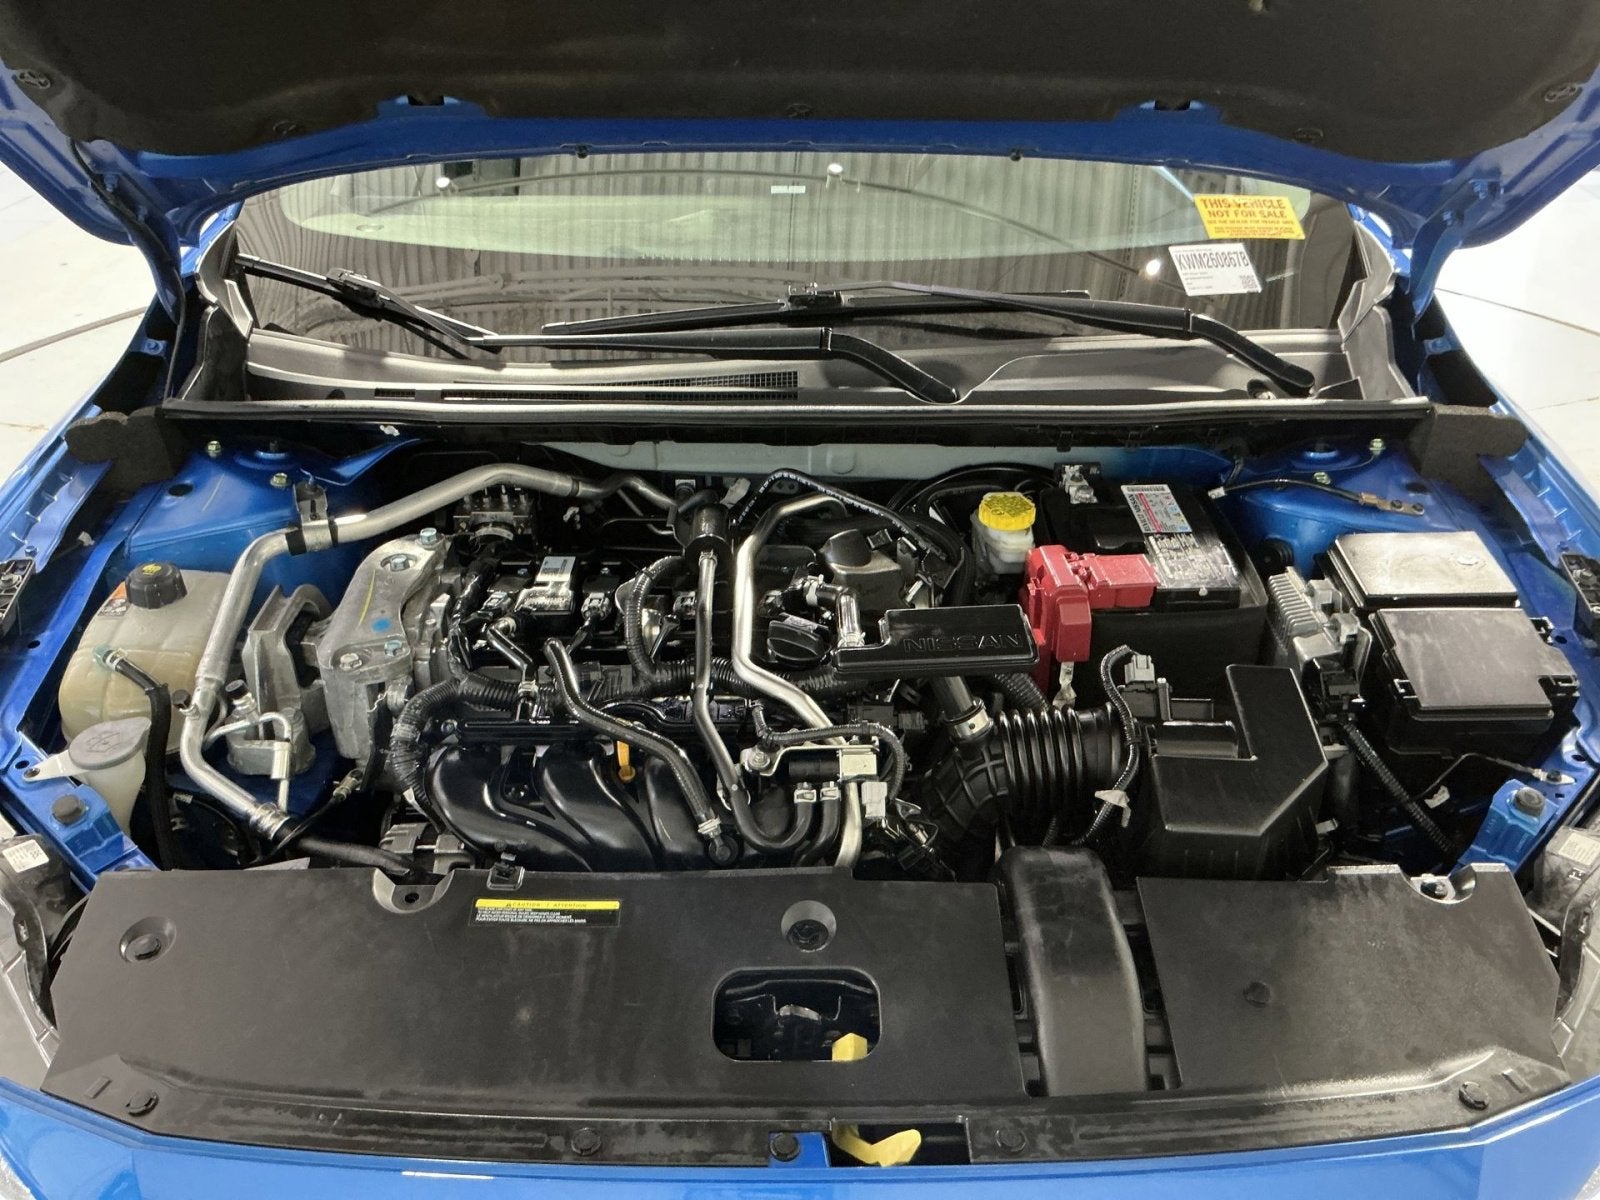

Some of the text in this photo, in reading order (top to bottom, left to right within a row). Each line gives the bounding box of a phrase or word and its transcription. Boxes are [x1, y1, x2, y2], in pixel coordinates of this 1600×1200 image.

[1200, 197, 1287, 210] THIS VEHICLE
[1208, 210, 1287, 219] NOT FOR SALE
[903, 633, 1023, 653] NISSAN
